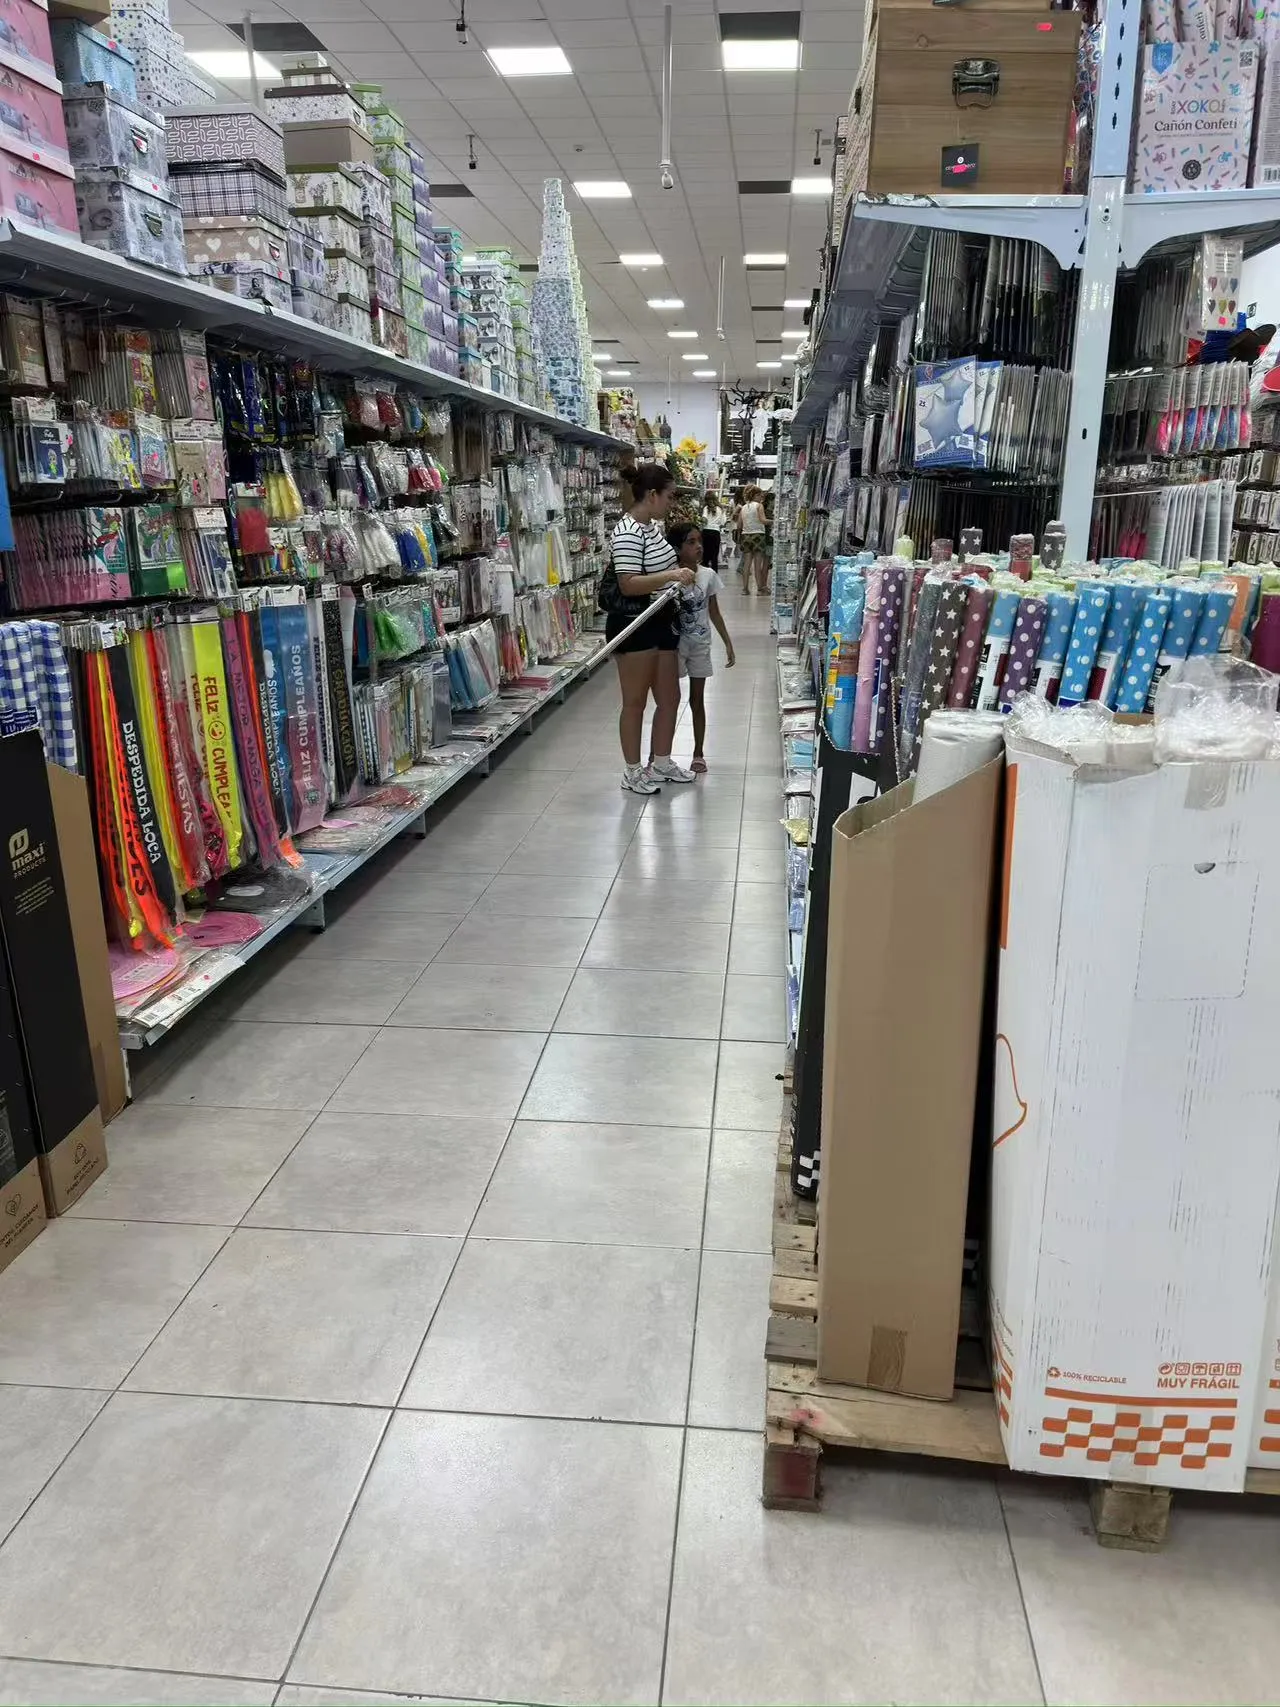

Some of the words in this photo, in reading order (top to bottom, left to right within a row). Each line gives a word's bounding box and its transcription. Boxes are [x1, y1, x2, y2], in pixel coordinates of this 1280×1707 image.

[1154, 119, 1193, 132] Cañón
[1194, 117, 1238, 130] Confeti
[291, 644, 309, 747] CUMPLEAÑOS
[203, 676, 218, 715] FELIZ
[212, 747, 234, 825] CUMPLEA
[300, 752, 312, 789] FELIZ
[122, 720, 152, 820] DESPEDIDA
[142, 819, 162, 865] LOCA
[175, 761, 195, 835] FIESTAS
[11, 841, 46, 871] maxi
[13, 856, 47, 879] PRODUCTS
[1062, 1371, 1082, 1381] 100%
[1083, 1374, 1127, 1384] RECICLABLE
[1157, 1377, 1188, 1389] MUY
[1190, 1376, 1240, 1390] FRÁGIL
